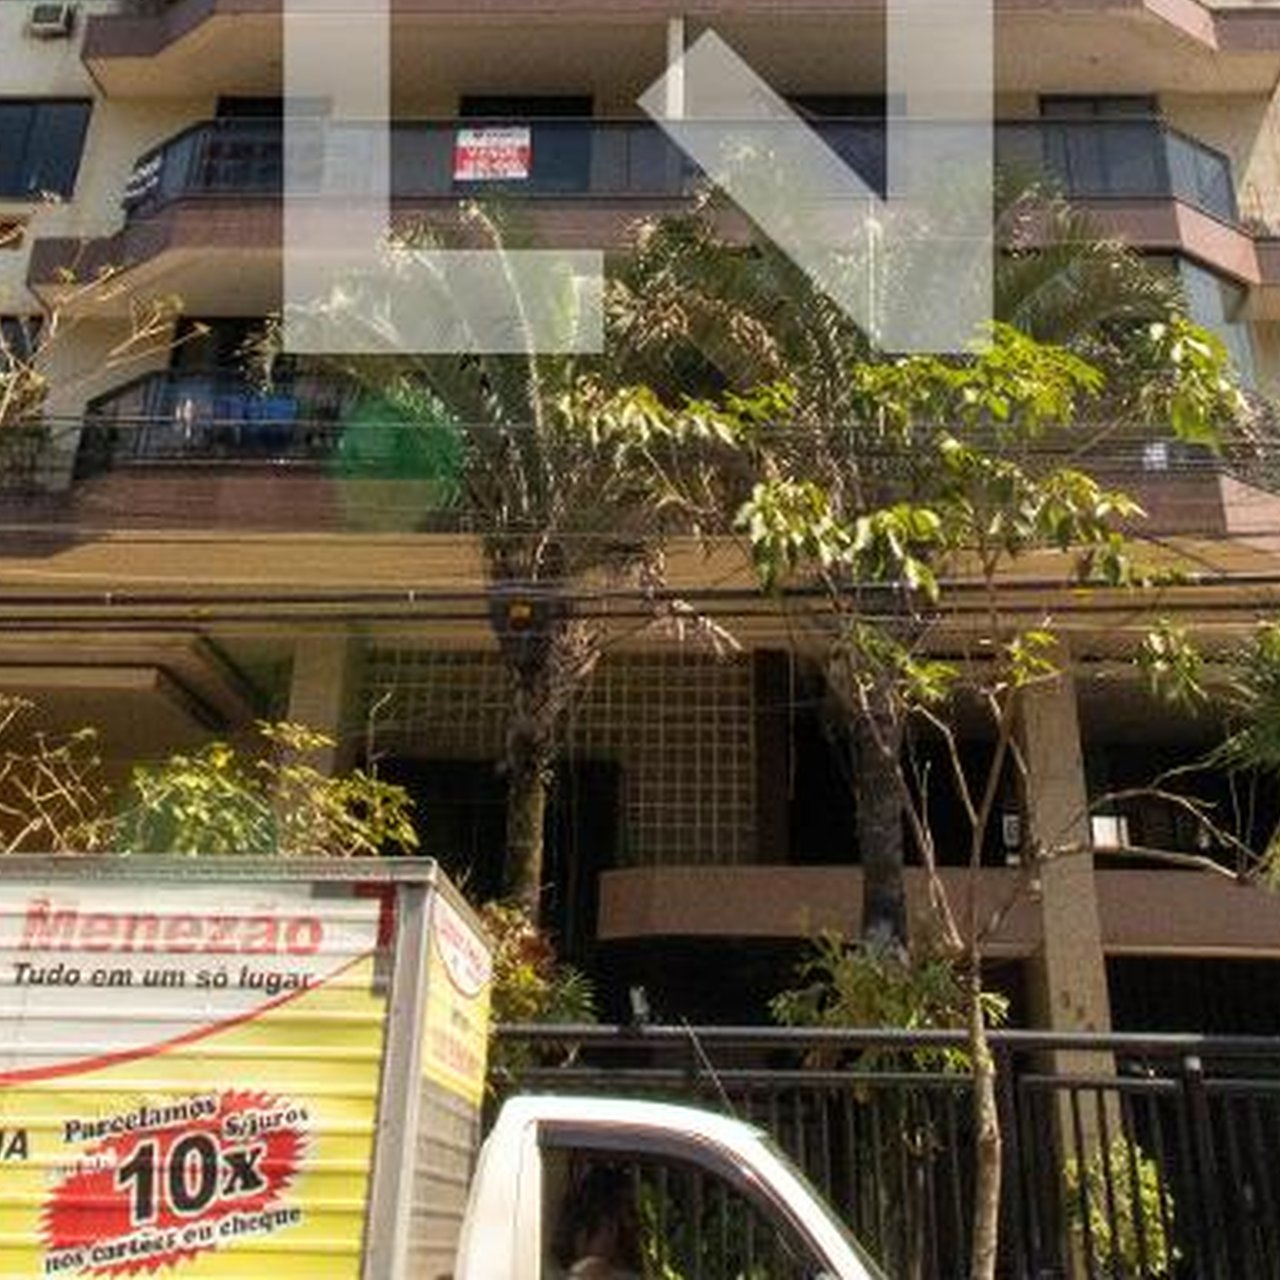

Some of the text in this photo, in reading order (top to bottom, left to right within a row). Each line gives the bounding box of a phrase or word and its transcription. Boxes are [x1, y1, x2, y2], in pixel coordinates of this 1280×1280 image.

[13, 962, 313, 996] Tudo em um só lugar
[63, 1095, 217, 1143] Parcelamos
[45, 1253, 85, 1274] nos
[219, 1204, 302, 1241] cheque
